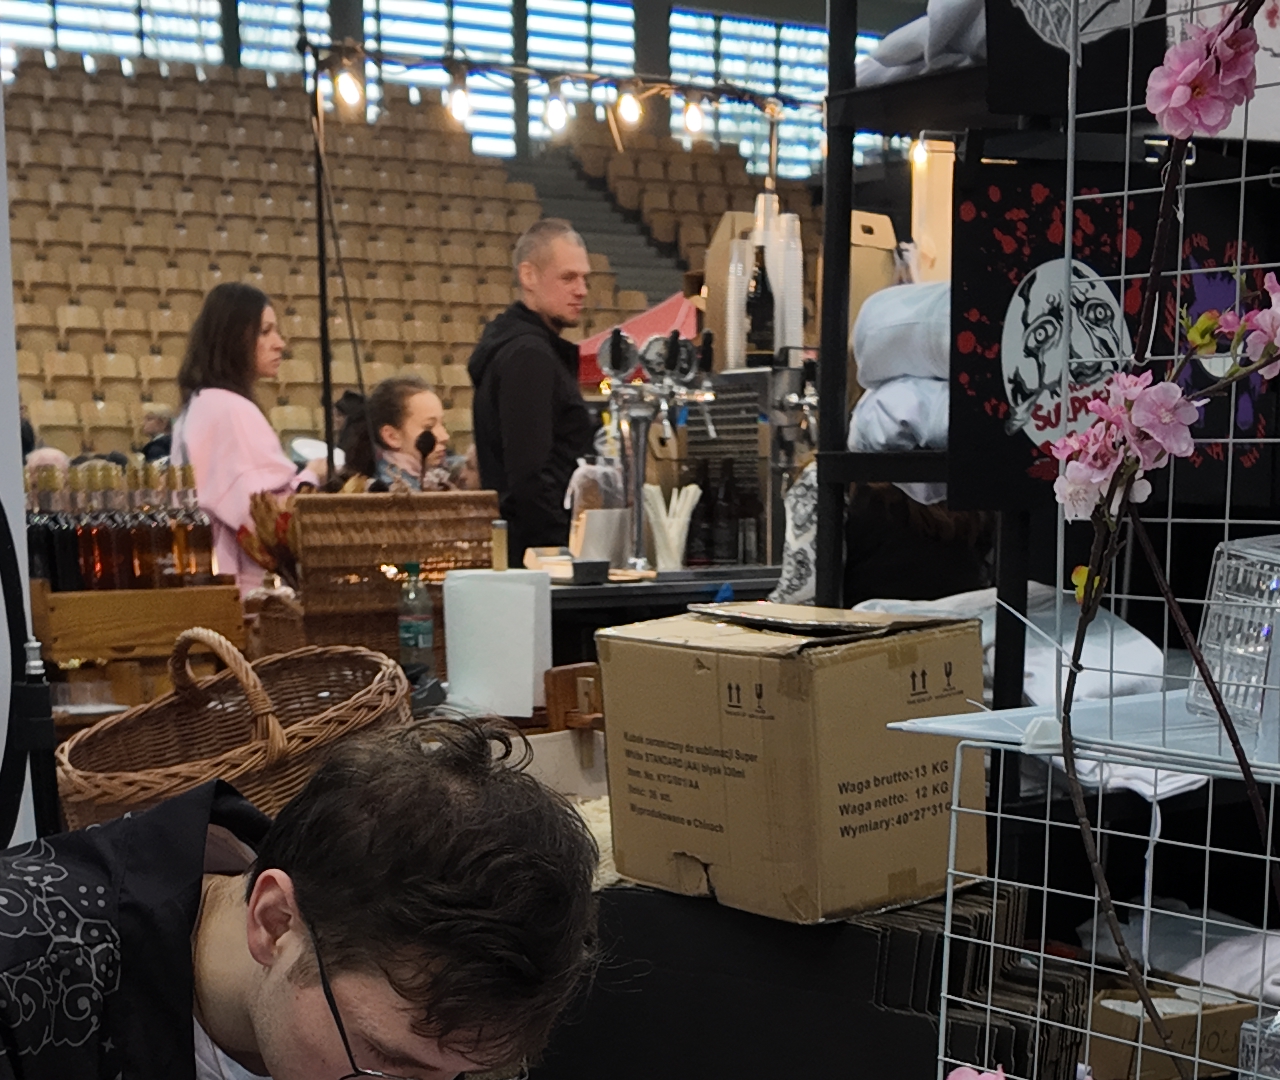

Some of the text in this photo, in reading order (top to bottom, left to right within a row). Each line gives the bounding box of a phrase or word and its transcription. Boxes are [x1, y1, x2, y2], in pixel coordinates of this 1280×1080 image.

[735, 750, 758, 763] Super
[837, 760, 949, 796] Waga brutto: 13 KG
[838, 781, 949, 816] Waga netto: 12 KG
[839, 818, 895, 839] Wymiary:
